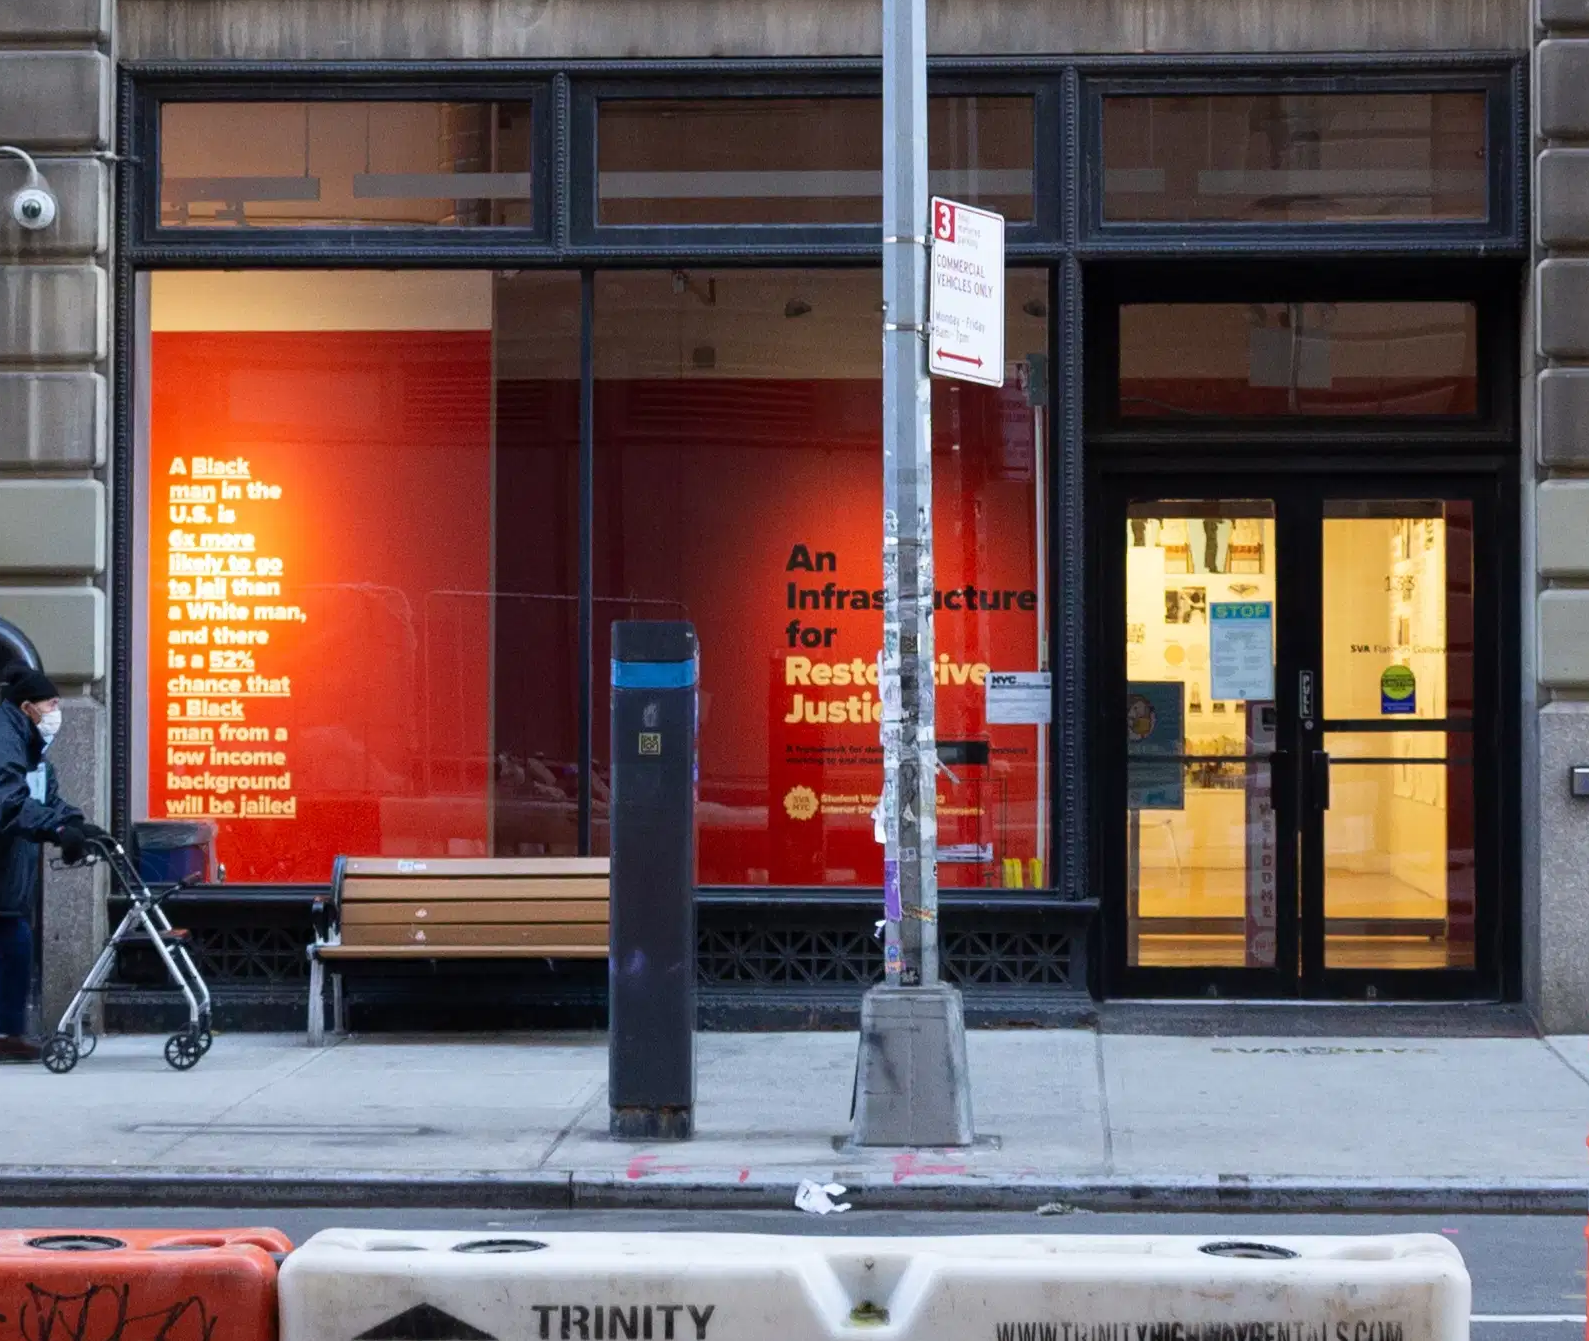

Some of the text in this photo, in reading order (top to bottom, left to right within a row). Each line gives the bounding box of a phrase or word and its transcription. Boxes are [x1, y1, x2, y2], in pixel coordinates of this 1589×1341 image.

[939, 204, 952, 240] 3
[936, 254, 986, 279] COMMERCIAL
[936, 272, 994, 299] VEHICLES ONLY
[169, 456, 251, 476] A Black
[169, 480, 283, 500] man in the
[169, 504, 236, 524] U.S. is
[168, 529, 256, 548] 6x more
[168, 553, 283, 576] likely to go
[785, 543, 836, 572] An
[168, 576, 281, 600] to jail than
[1383, 575, 1416, 592] 133
[168, 601, 307, 624] a White man,
[1216, 604, 1267, 618] STOP
[168, 626, 270, 645] and there
[785, 618, 838, 649] for
[168, 649, 256, 669] is a 52%
[1350, 644, 1370, 654] SVA
[167, 674, 292, 693] chance that
[991, 675, 1017, 685] NYC
[167, 699, 246, 718] a Black
[784, 691, 884, 724] Justic
[167, 723, 289, 742] man from a
[167, 746, 287, 766] low income
[166, 771, 292, 794] background
[166, 795, 297, 818] will be jailed
[531, 1304, 716, 1341] TRINITY
